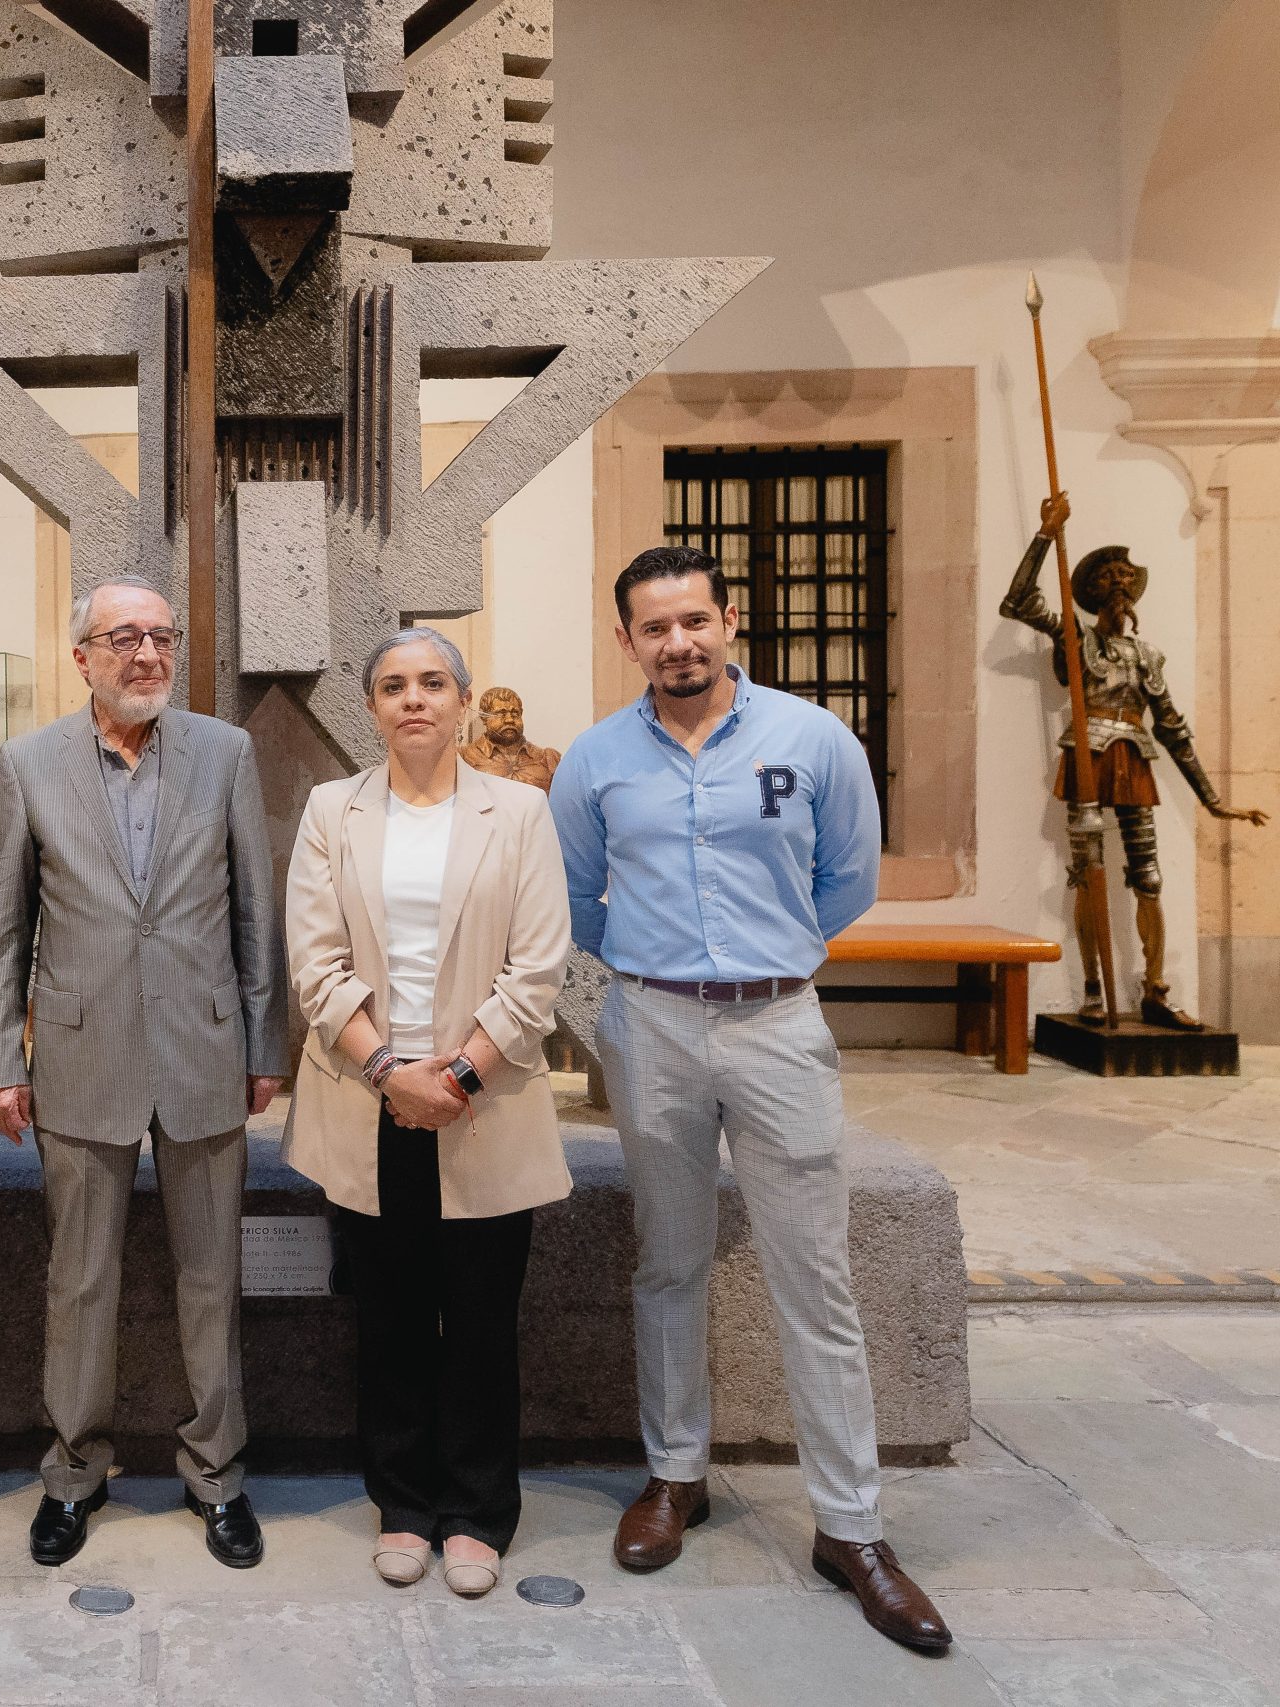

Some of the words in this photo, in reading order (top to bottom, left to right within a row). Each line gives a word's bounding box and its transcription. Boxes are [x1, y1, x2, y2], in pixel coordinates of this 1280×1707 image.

[755, 764, 797, 818] P
[240, 1227, 270, 1235] ERICO
[273, 1227, 299, 1235] SILVA
[264, 1235, 275, 1243] de
[241, 1264, 270, 1272] ncreto
